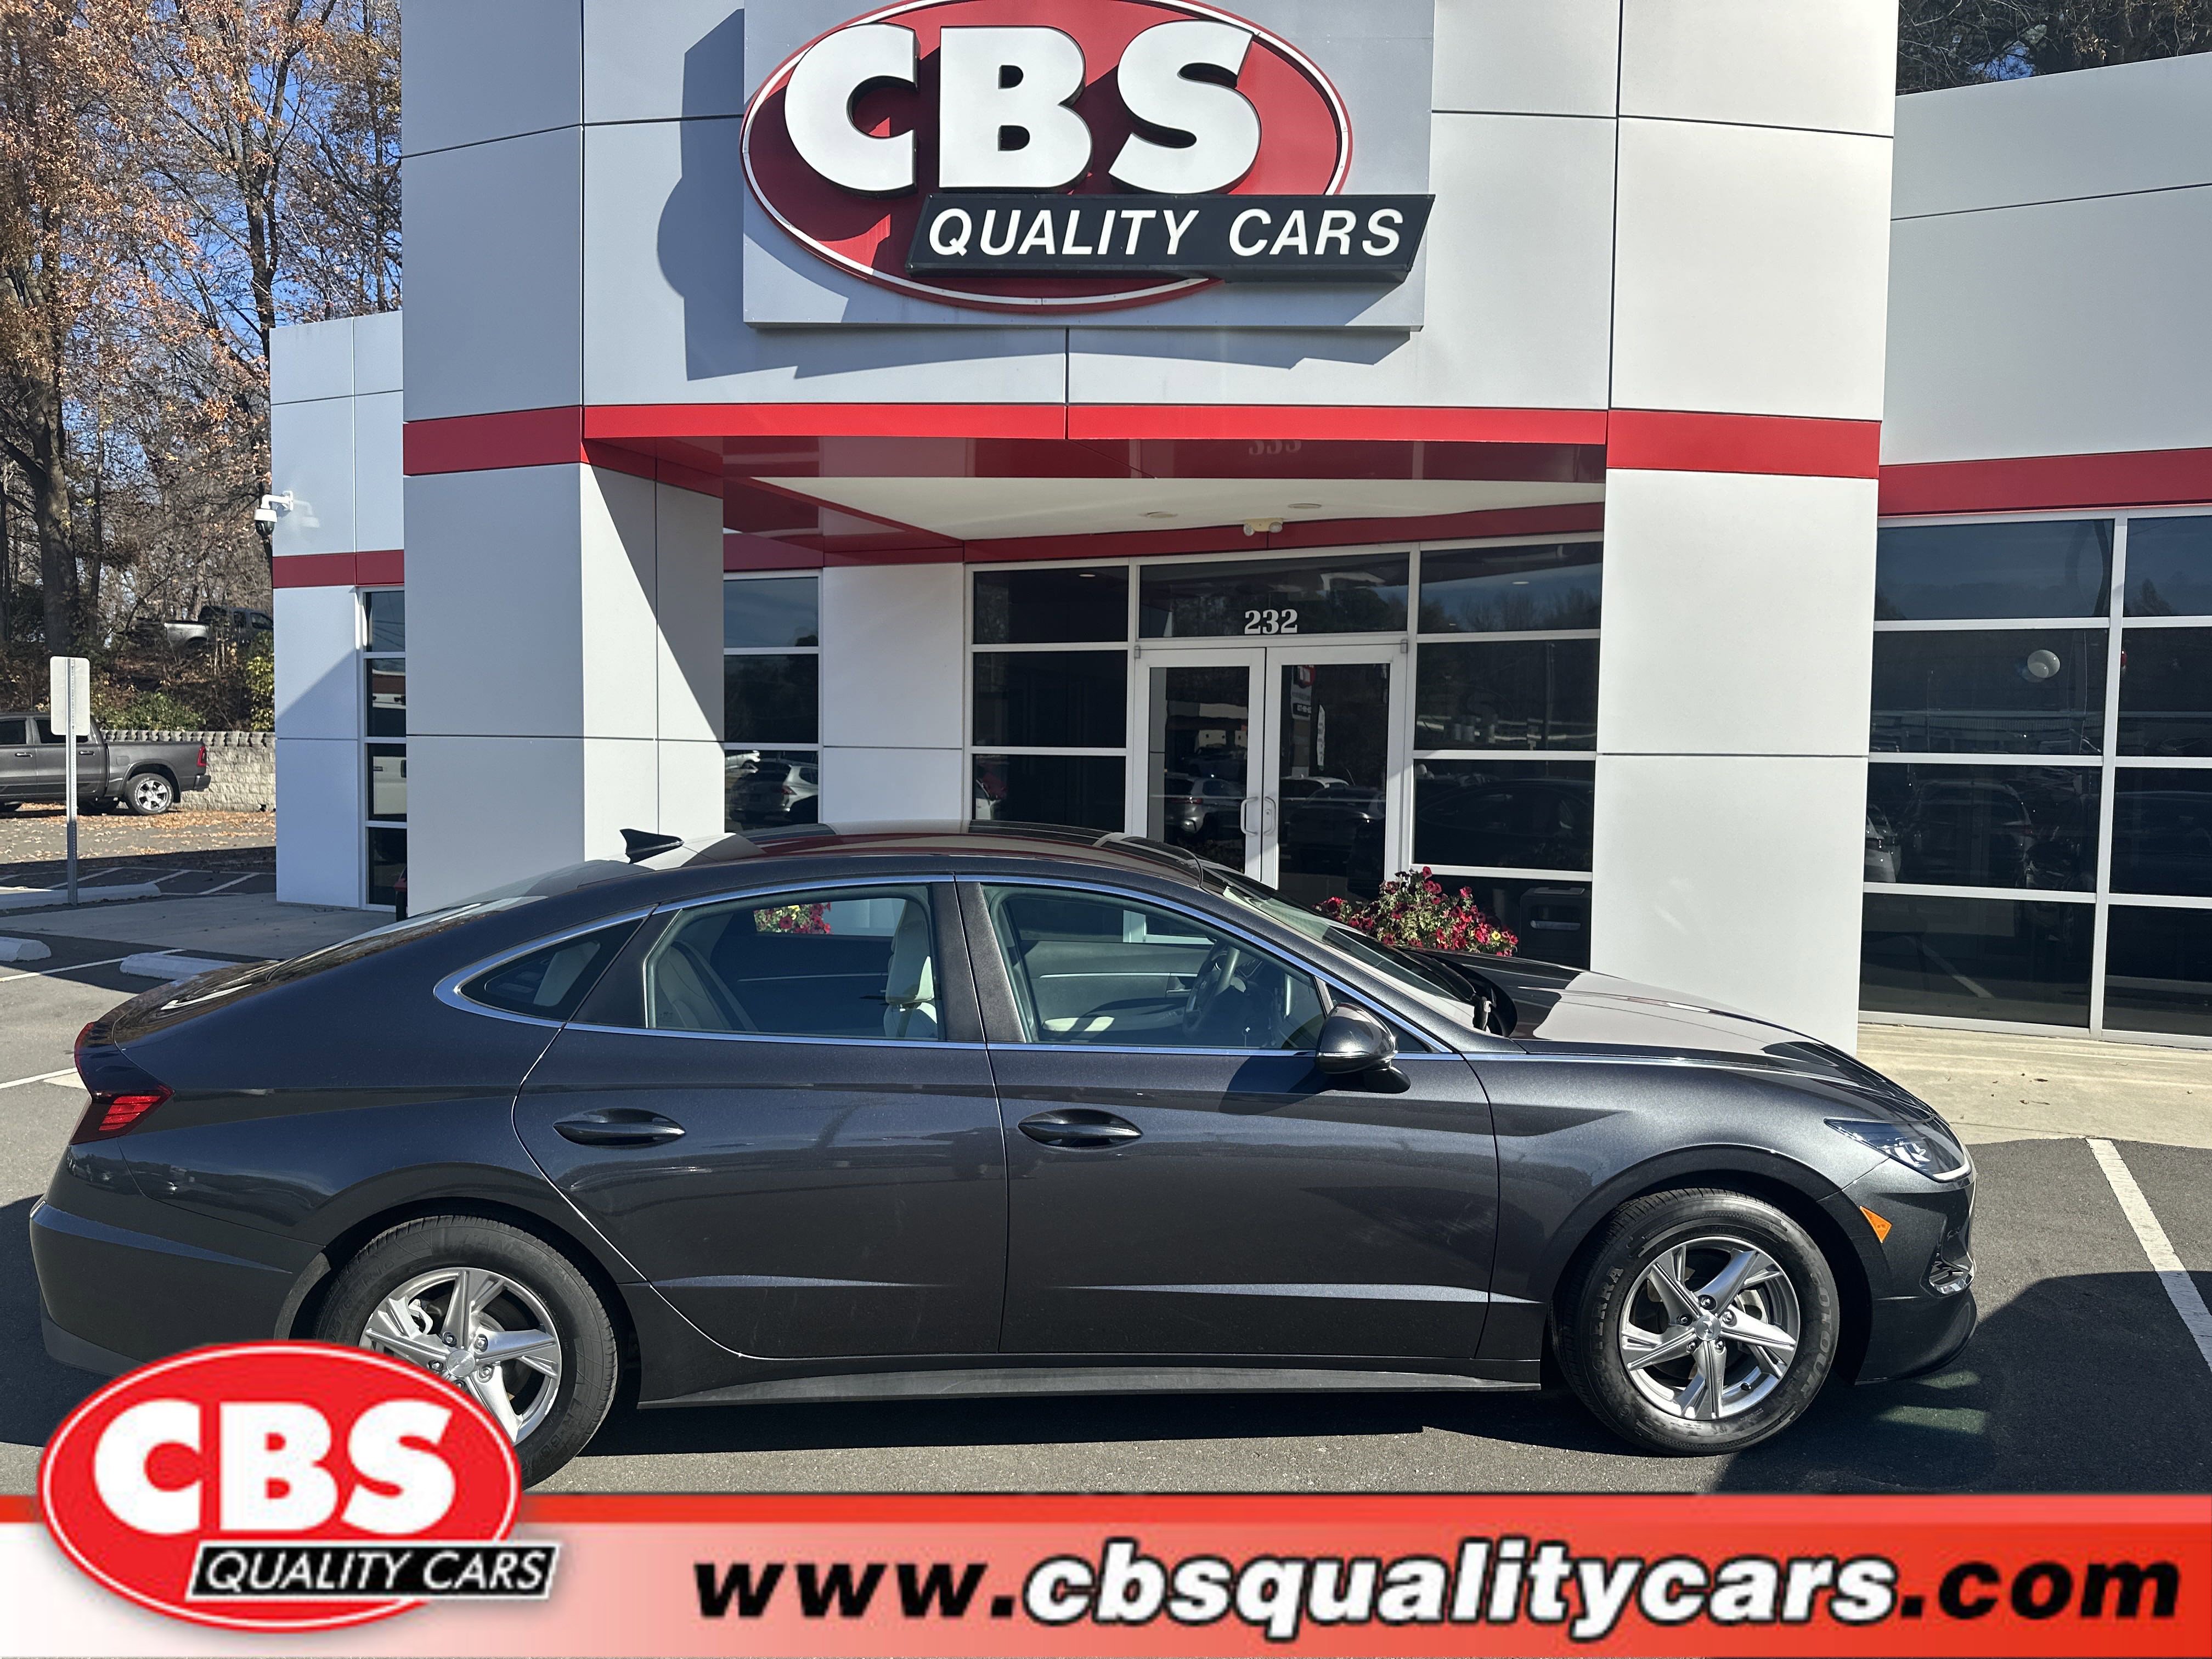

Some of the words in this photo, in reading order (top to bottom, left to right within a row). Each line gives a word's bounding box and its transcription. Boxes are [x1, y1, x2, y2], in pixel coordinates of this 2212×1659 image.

[784, 20, 1262, 194] CBS
[928, 207, 1199, 258] QUALITY
[1228, 206, 1404, 258] CARS
[1243, 608, 1298, 635] 232
